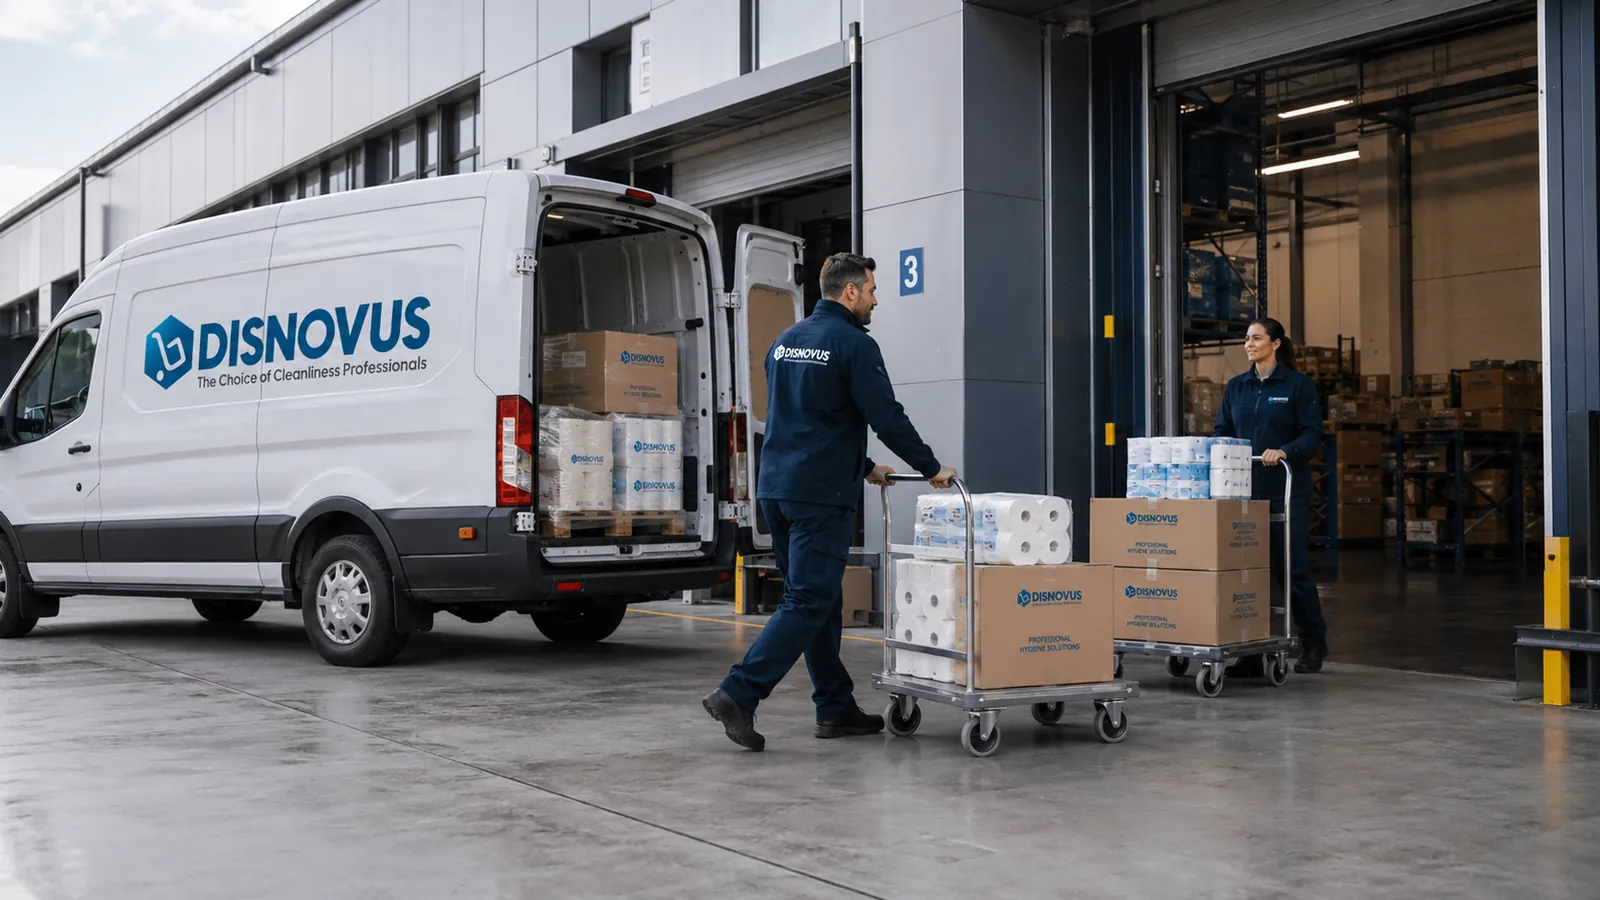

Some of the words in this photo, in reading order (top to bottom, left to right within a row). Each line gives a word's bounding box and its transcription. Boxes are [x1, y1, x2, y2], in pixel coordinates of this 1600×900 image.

[904, 255, 918, 288] 3
[198, 296, 431, 370] DISNOVUS
[631, 353, 664, 364] DISNOVUS
[785, 347, 830, 361] DISNOVUS
[197, 376, 216, 388] The
[219, 372, 257, 386] Choice
[260, 369, 271, 382] of
[273, 365, 340, 381] Cleanliness
[343, 356, 427, 376] Professionals
[1138, 514, 1178, 523] DISNOVUS
[1032, 590, 1082, 602] DISNOVUS
[1136, 587, 1178, 597] DISNOVUS
[1020, 645, 1045, 653] HYGIENE
[1047, 643, 1080, 652] SOLUTIONS
